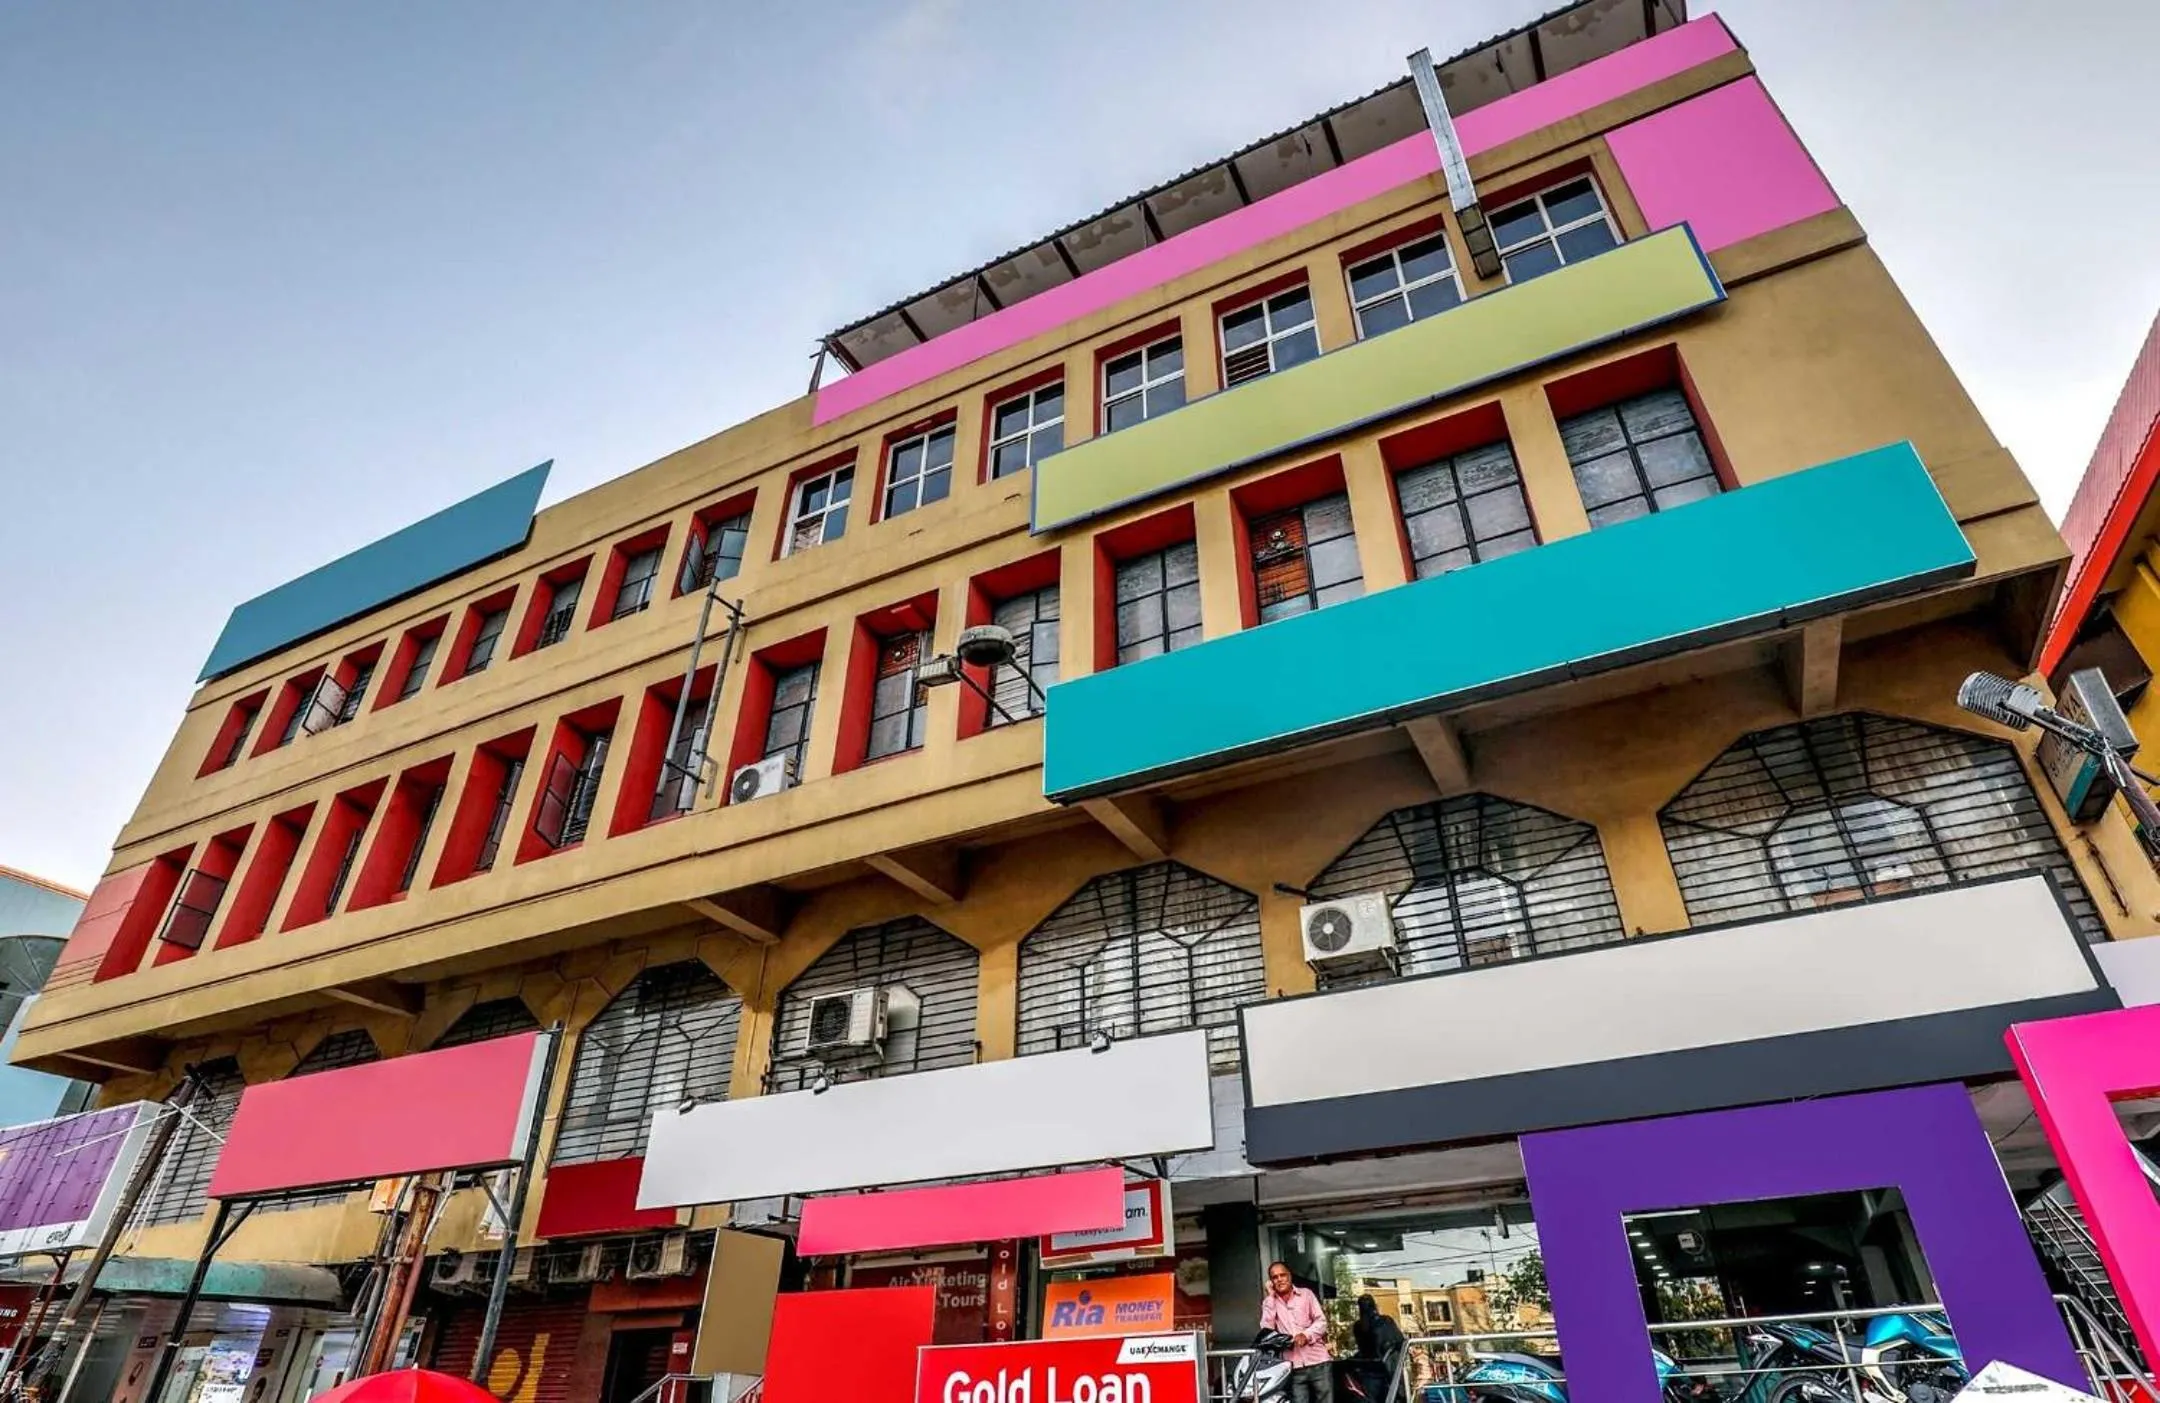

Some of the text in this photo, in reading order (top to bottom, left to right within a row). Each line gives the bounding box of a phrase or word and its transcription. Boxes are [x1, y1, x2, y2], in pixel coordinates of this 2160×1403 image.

[1126, 1206, 1148, 1219] am.
[940, 1291, 986, 1308] Tours
[1051, 1290, 1164, 1327] Ria MONEY
[944, 1366, 1151, 1403] Gold Loan
